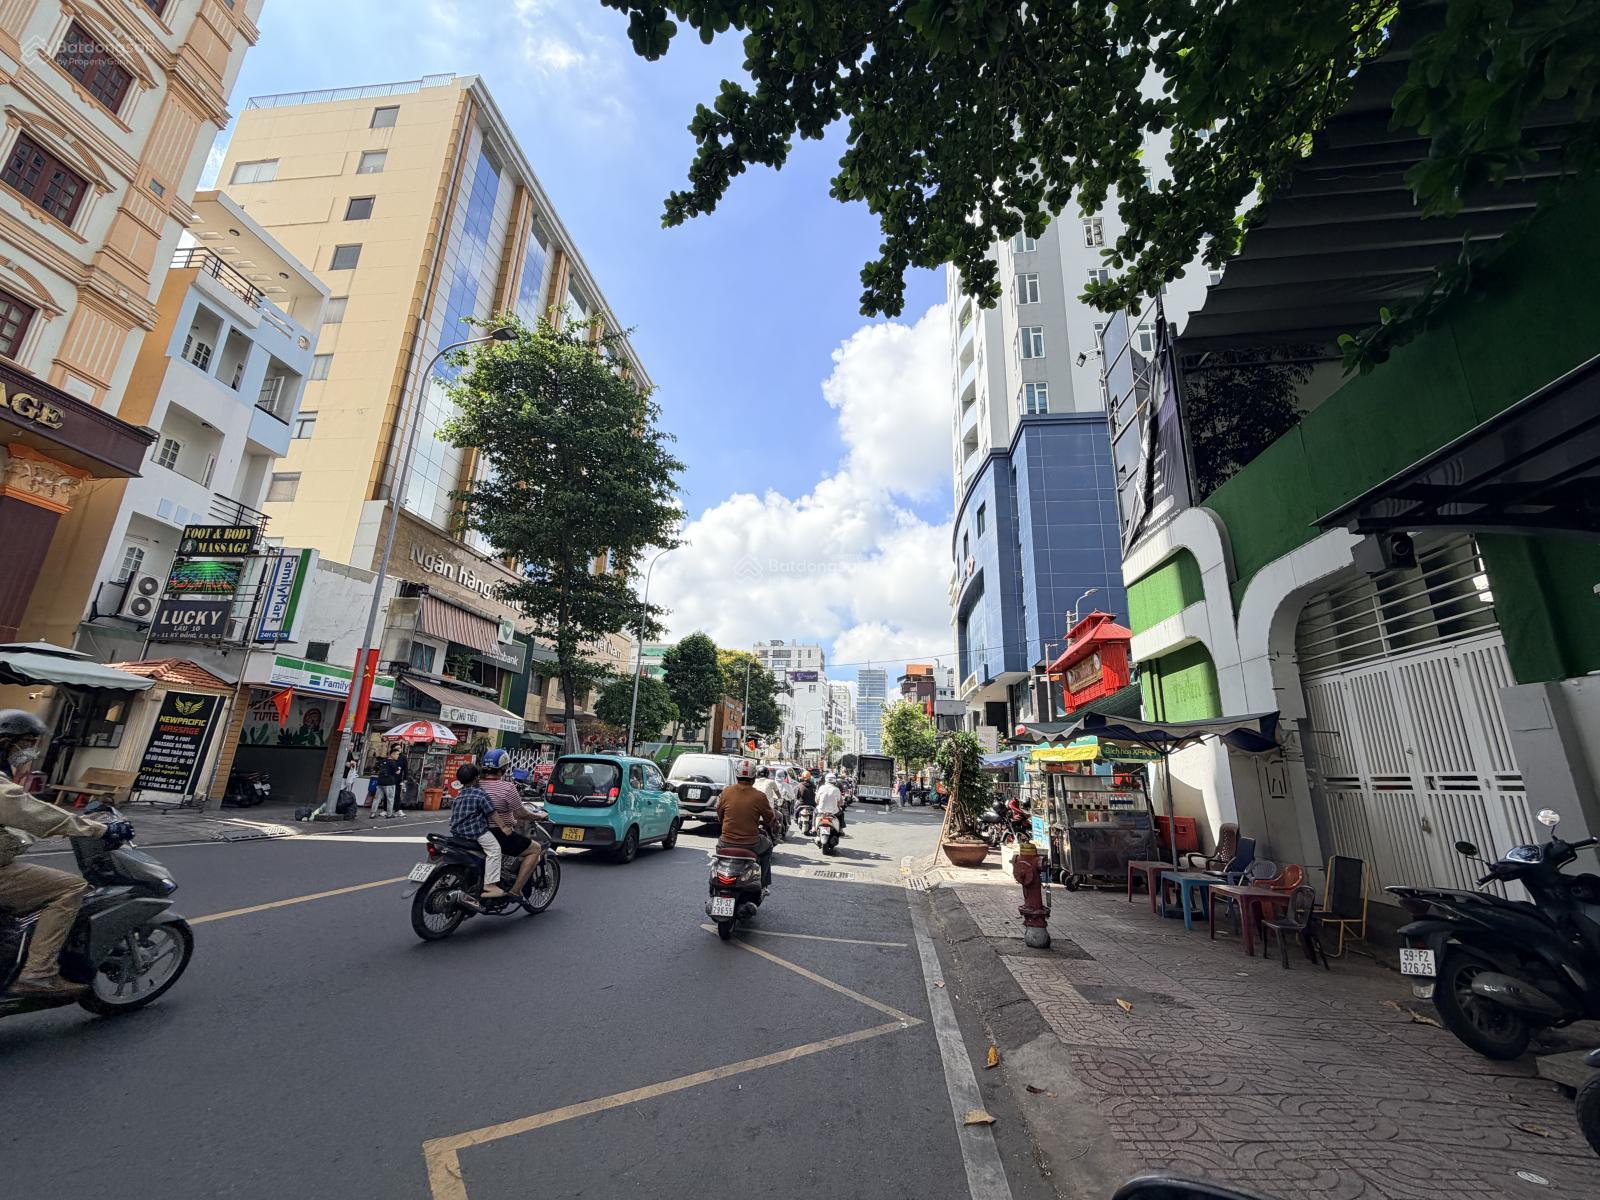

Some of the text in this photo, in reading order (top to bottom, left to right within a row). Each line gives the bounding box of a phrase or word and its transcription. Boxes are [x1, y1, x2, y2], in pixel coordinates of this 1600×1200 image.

[184, 527, 254, 540] FOOT & BODY
[197, 542, 250, 554] MASSAGE
[409, 542, 454, 579] Ngân
[458, 566, 493, 600] hàng
[270, 556, 299, 624] FamilyMart
[160, 610, 223, 625] LUCKY
[159, 716, 206, 726] NEWPACIFIC
[253, 711, 279, 722] TIME
[160, 725, 201, 735] MASSAGE
[1403, 950, 1428, 962] 59-F2
[1402, 962, 1433, 975] 326.25
